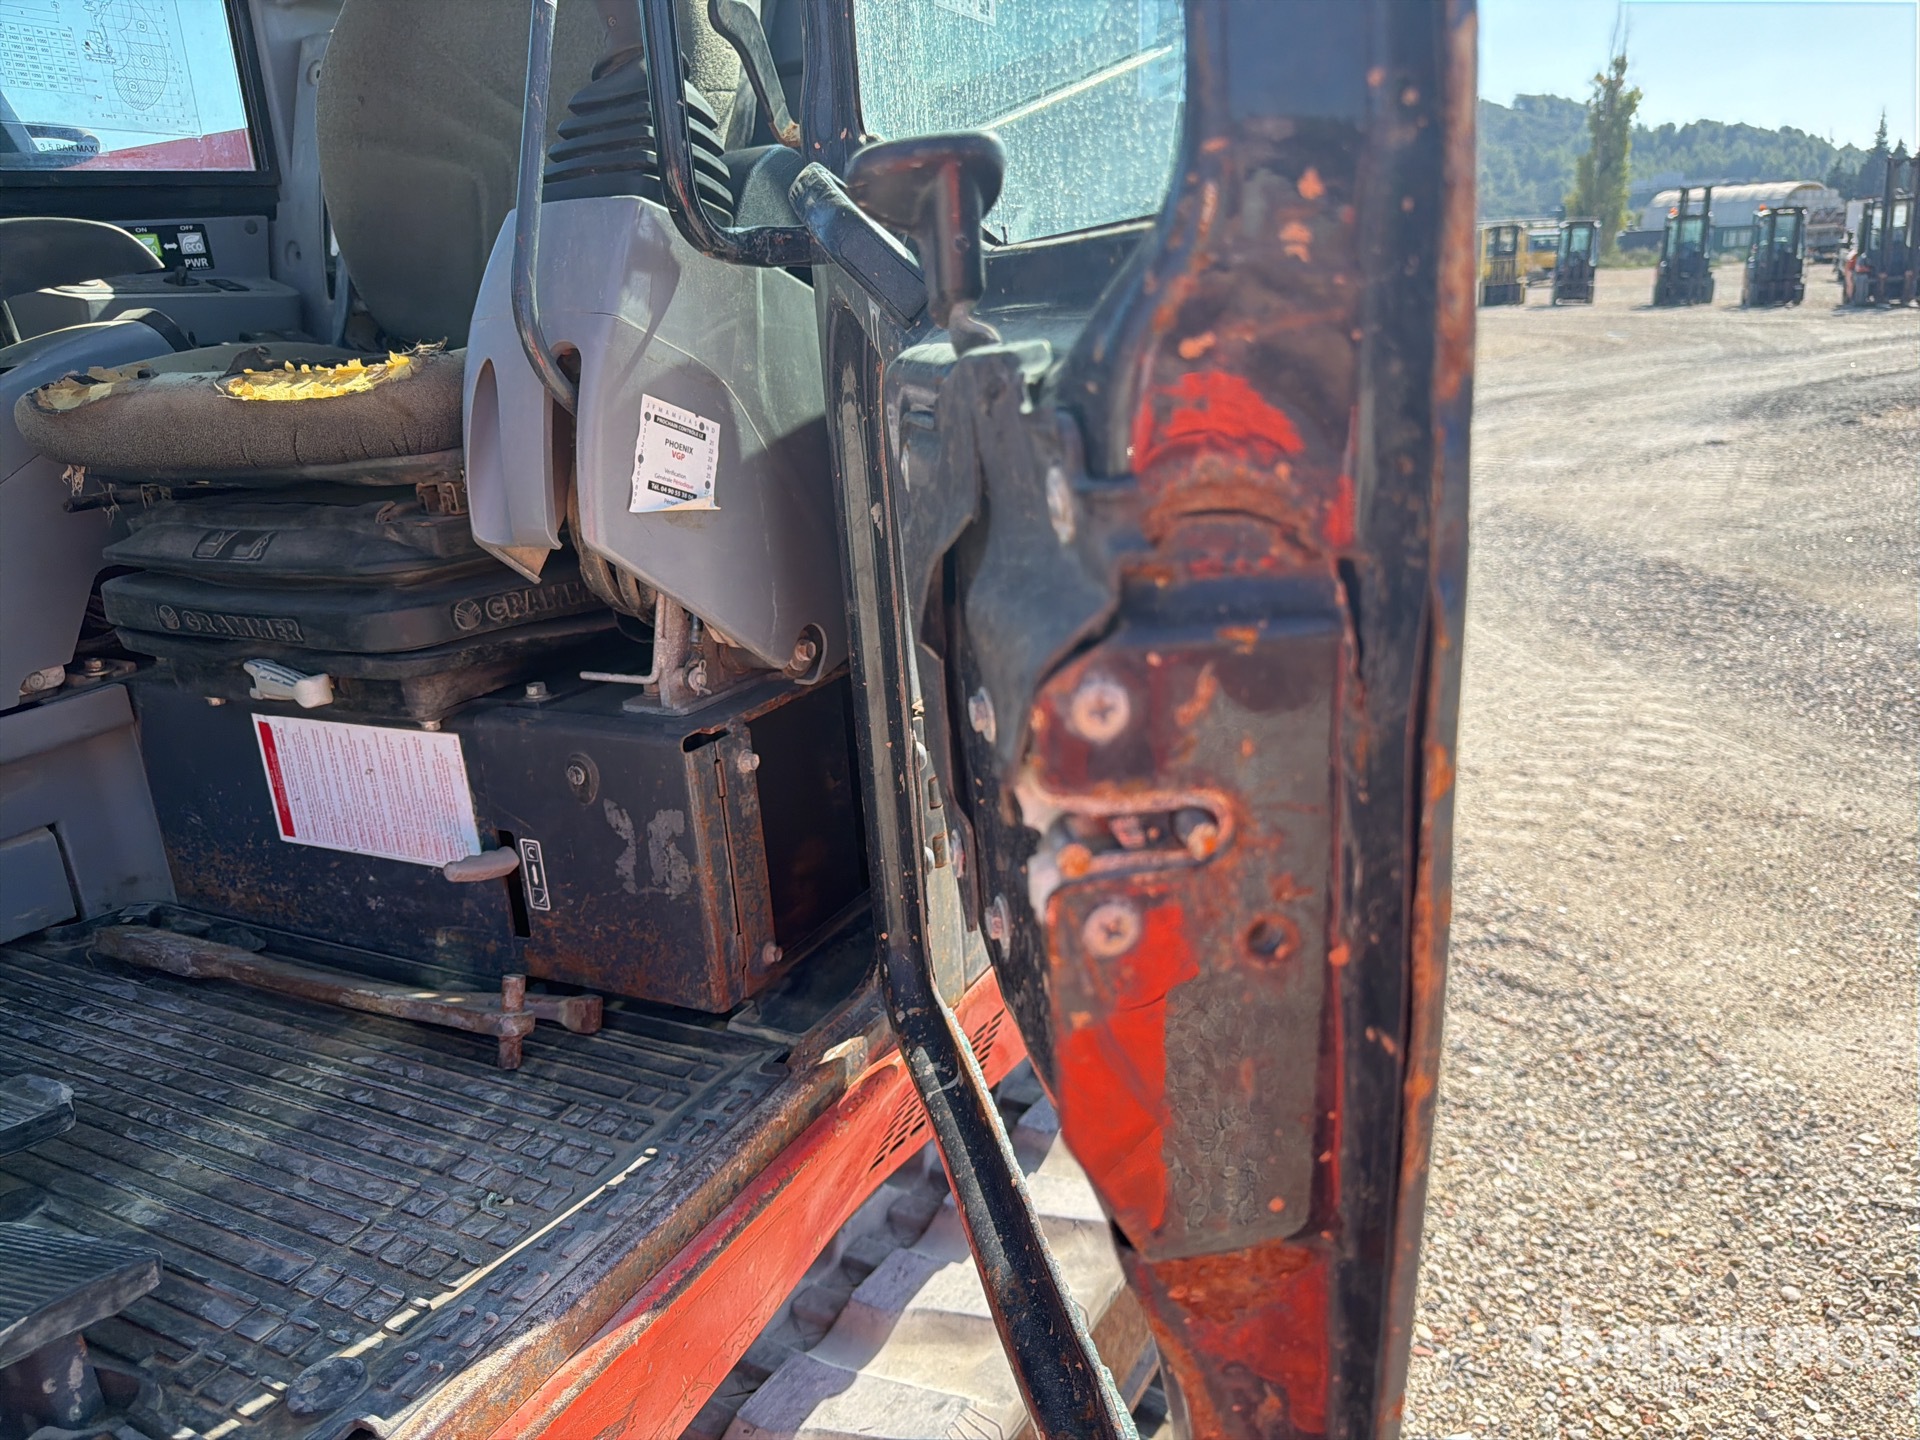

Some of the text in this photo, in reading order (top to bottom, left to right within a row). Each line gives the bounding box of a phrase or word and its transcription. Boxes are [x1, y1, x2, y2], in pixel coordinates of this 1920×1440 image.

[56, 144, 74, 152] BAR
[185, 242, 202, 252] eco
[184, 258, 208, 268] PWR
[664, 438, 694, 456] PHOENIX
[672, 450, 686, 460] VGP
[182, 610, 304, 641] GRAMMER
